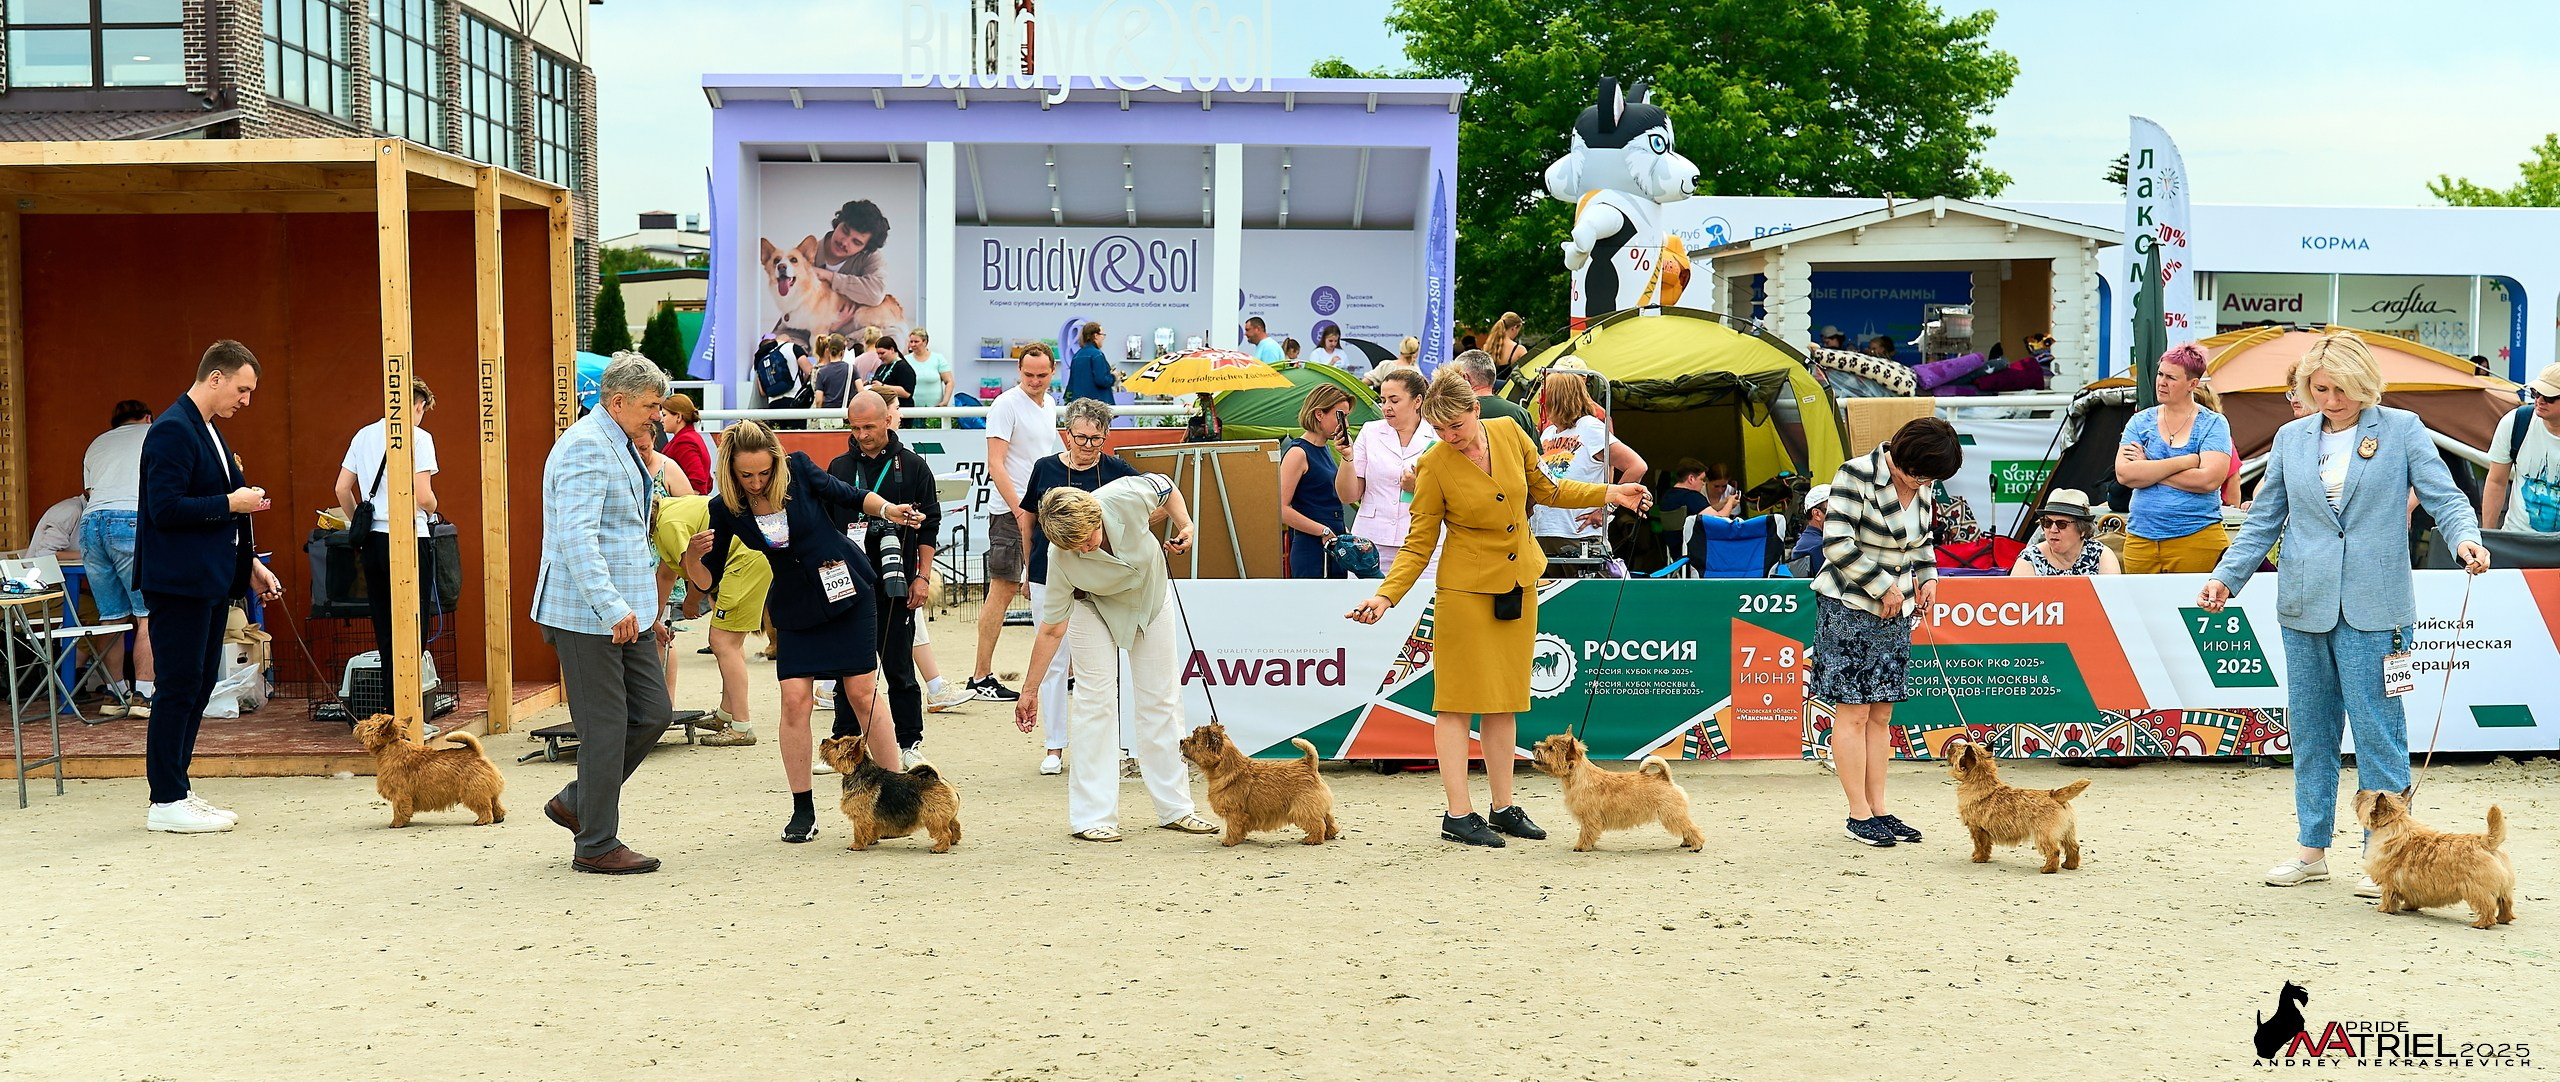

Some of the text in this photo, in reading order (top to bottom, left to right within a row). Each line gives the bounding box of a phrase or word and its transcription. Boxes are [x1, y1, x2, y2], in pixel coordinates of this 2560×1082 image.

[2302, 236, 2370, 250] КОРМА
[1841, 289, 1936, 300] ПРОГРАММЫ
[2222, 293, 2302, 312] Award
[389, 358, 402, 450] CORNER
[481, 363, 494, 443] CORNER
[825, 576, 851, 591] 2092
[1739, 594, 1798, 613] 2025
[1932, 602, 2064, 627] РОССИЯ
[2412, 617, 2474, 630] сийская
[1584, 640, 1697, 660] РОССИЯ
[2203, 640, 2251, 651] ИЮНЯ
[2409, 639, 2512, 651] ологическая
[1181, 648, 1346, 685] Award
[1946, 659, 1984, 668] КУБОК
[1988, 659, 2010, 667] РКФ
[2014, 658, 2045, 667] 2025»
[2216, 659, 2262, 674] 2025
[1740, 672, 1795, 684] ИЮНЯ
[1945, 675, 1983, 685] КУБОК
[1987, 676, 2038, 684] МОСКВЫ
[2041, 676, 2049, 684] &
[2386, 670, 2411, 683] 2096
[1612, 688, 1681, 696] ГОРОДОВ-ГЕРОЕВ
[1927, 687, 2027, 697] ГОРОДОВ-ГЕРОЕВ
[2030, 686, 2062, 696] 2025»
